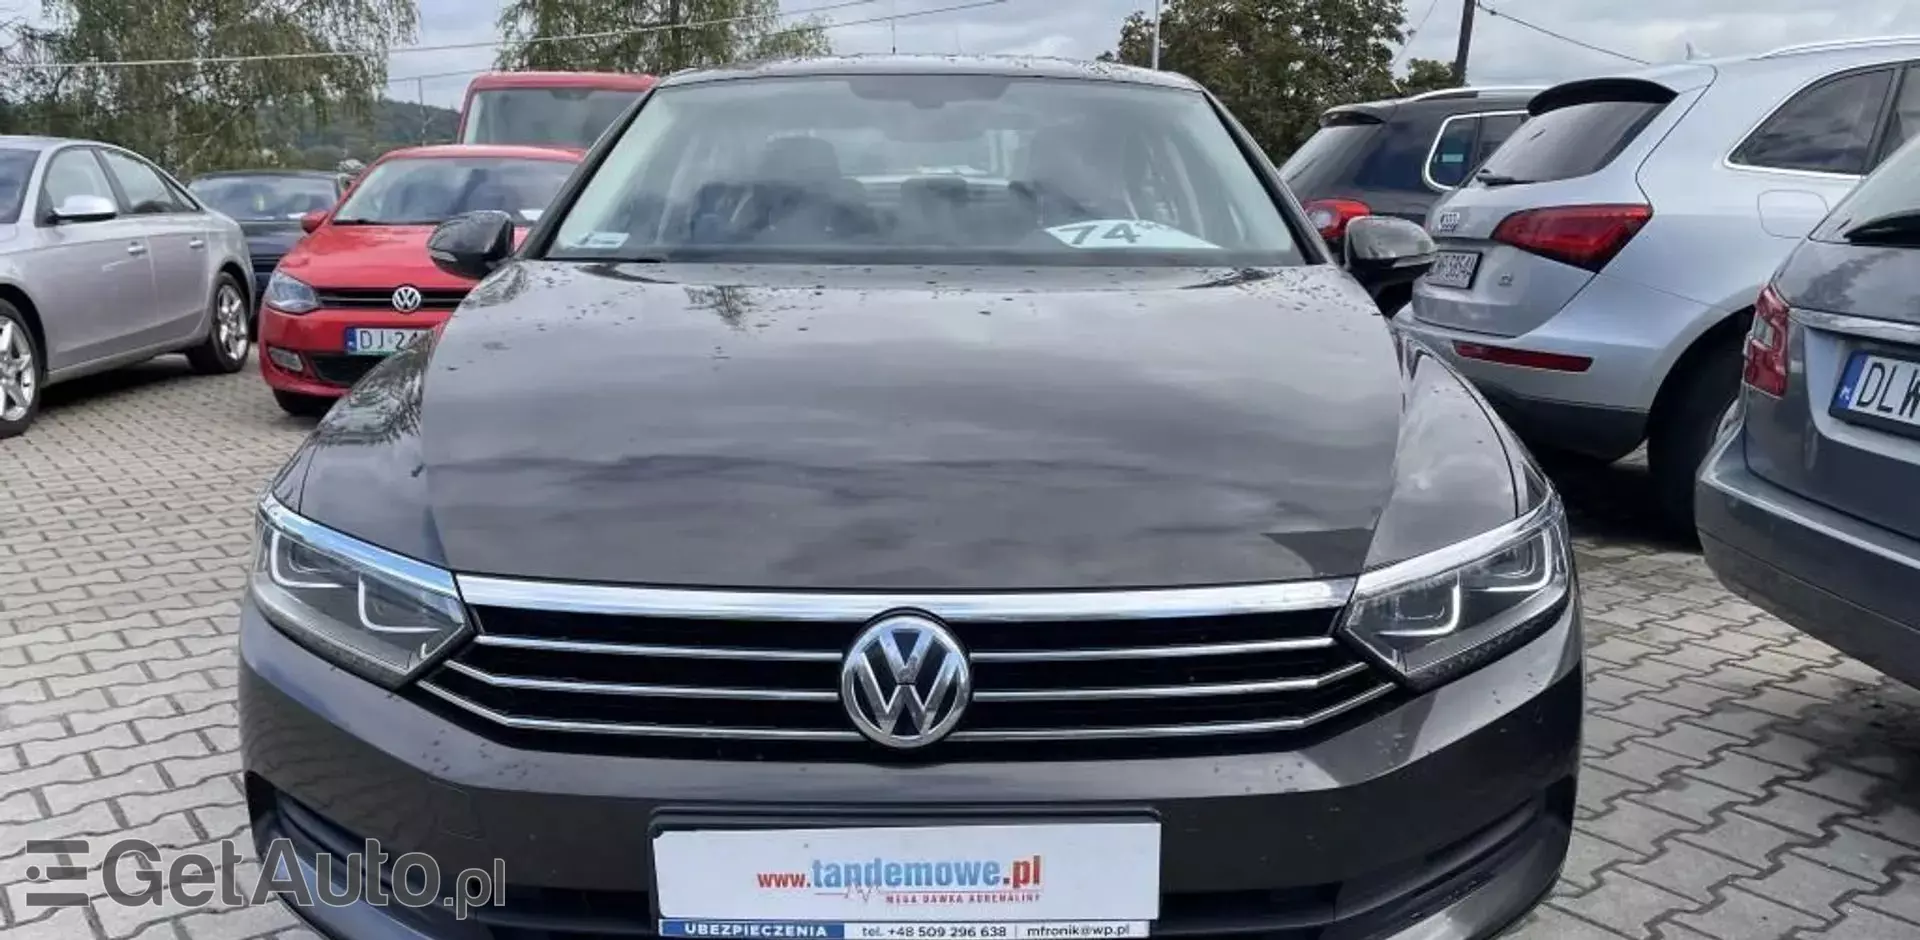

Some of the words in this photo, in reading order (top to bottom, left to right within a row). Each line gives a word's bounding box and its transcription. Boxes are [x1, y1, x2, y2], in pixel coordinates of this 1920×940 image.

[1057, 222, 1141, 245] 74
[360, 329, 385, 349] DJ
[757, 855, 1041, 889] www.tandemowe.pl
[886, 894, 917, 904] MEGA
[923, 894, 964, 904] DAWKA
[968, 892, 1041, 903] ADRENALINY
[684, 922, 828, 937] UBEZPIECZENIA
[862, 926, 883, 937] tel.
[888, 926, 915, 937] +48
[918, 926, 946, 937] 509
[950, 926, 977, 937] 296
[980, 926, 1007, 937] 638
